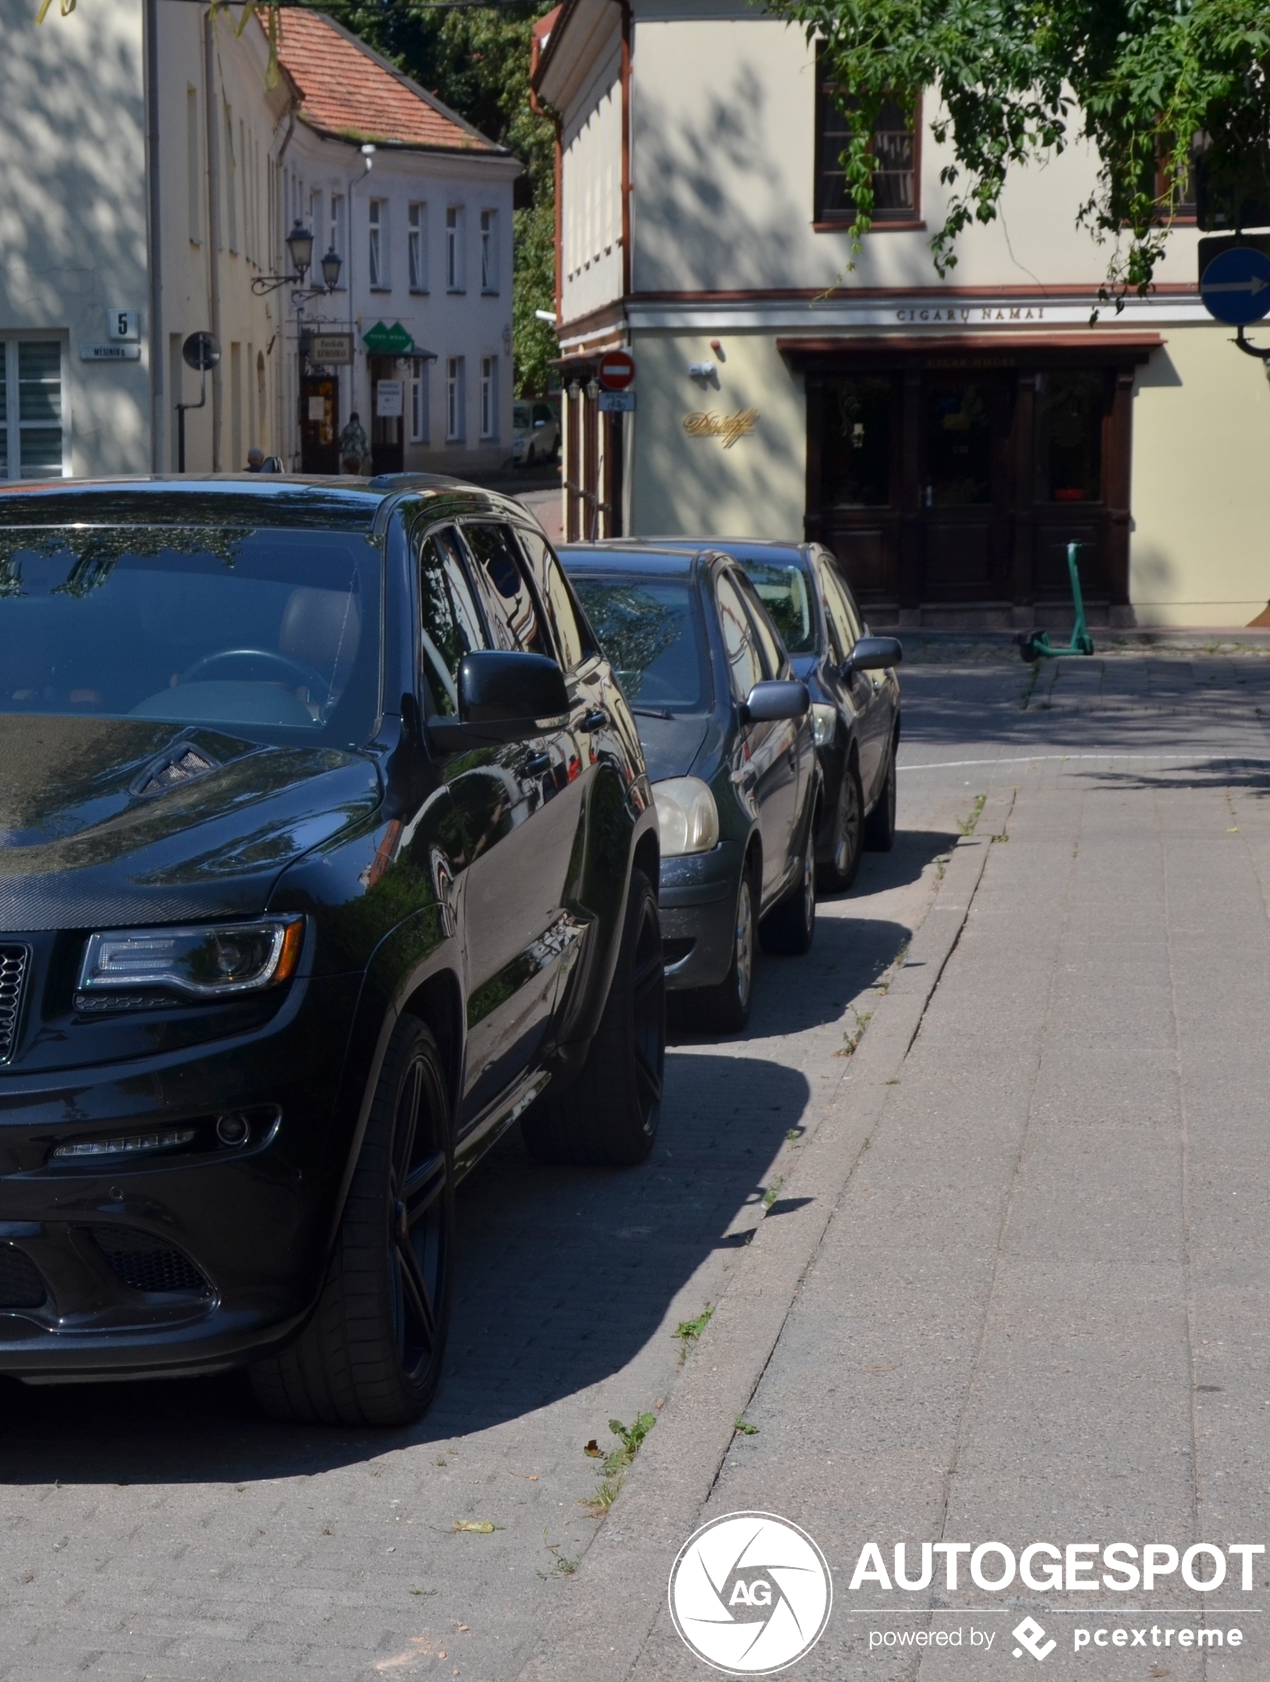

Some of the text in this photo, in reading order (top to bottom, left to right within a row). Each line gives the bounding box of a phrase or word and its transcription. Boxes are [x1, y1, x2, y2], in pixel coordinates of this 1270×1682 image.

[118, 313, 128, 335] 5
[896, 308, 1045, 325] CIGARŲ NAMAI
[927, 357, 1017, 367] CIGAR HOUSE
